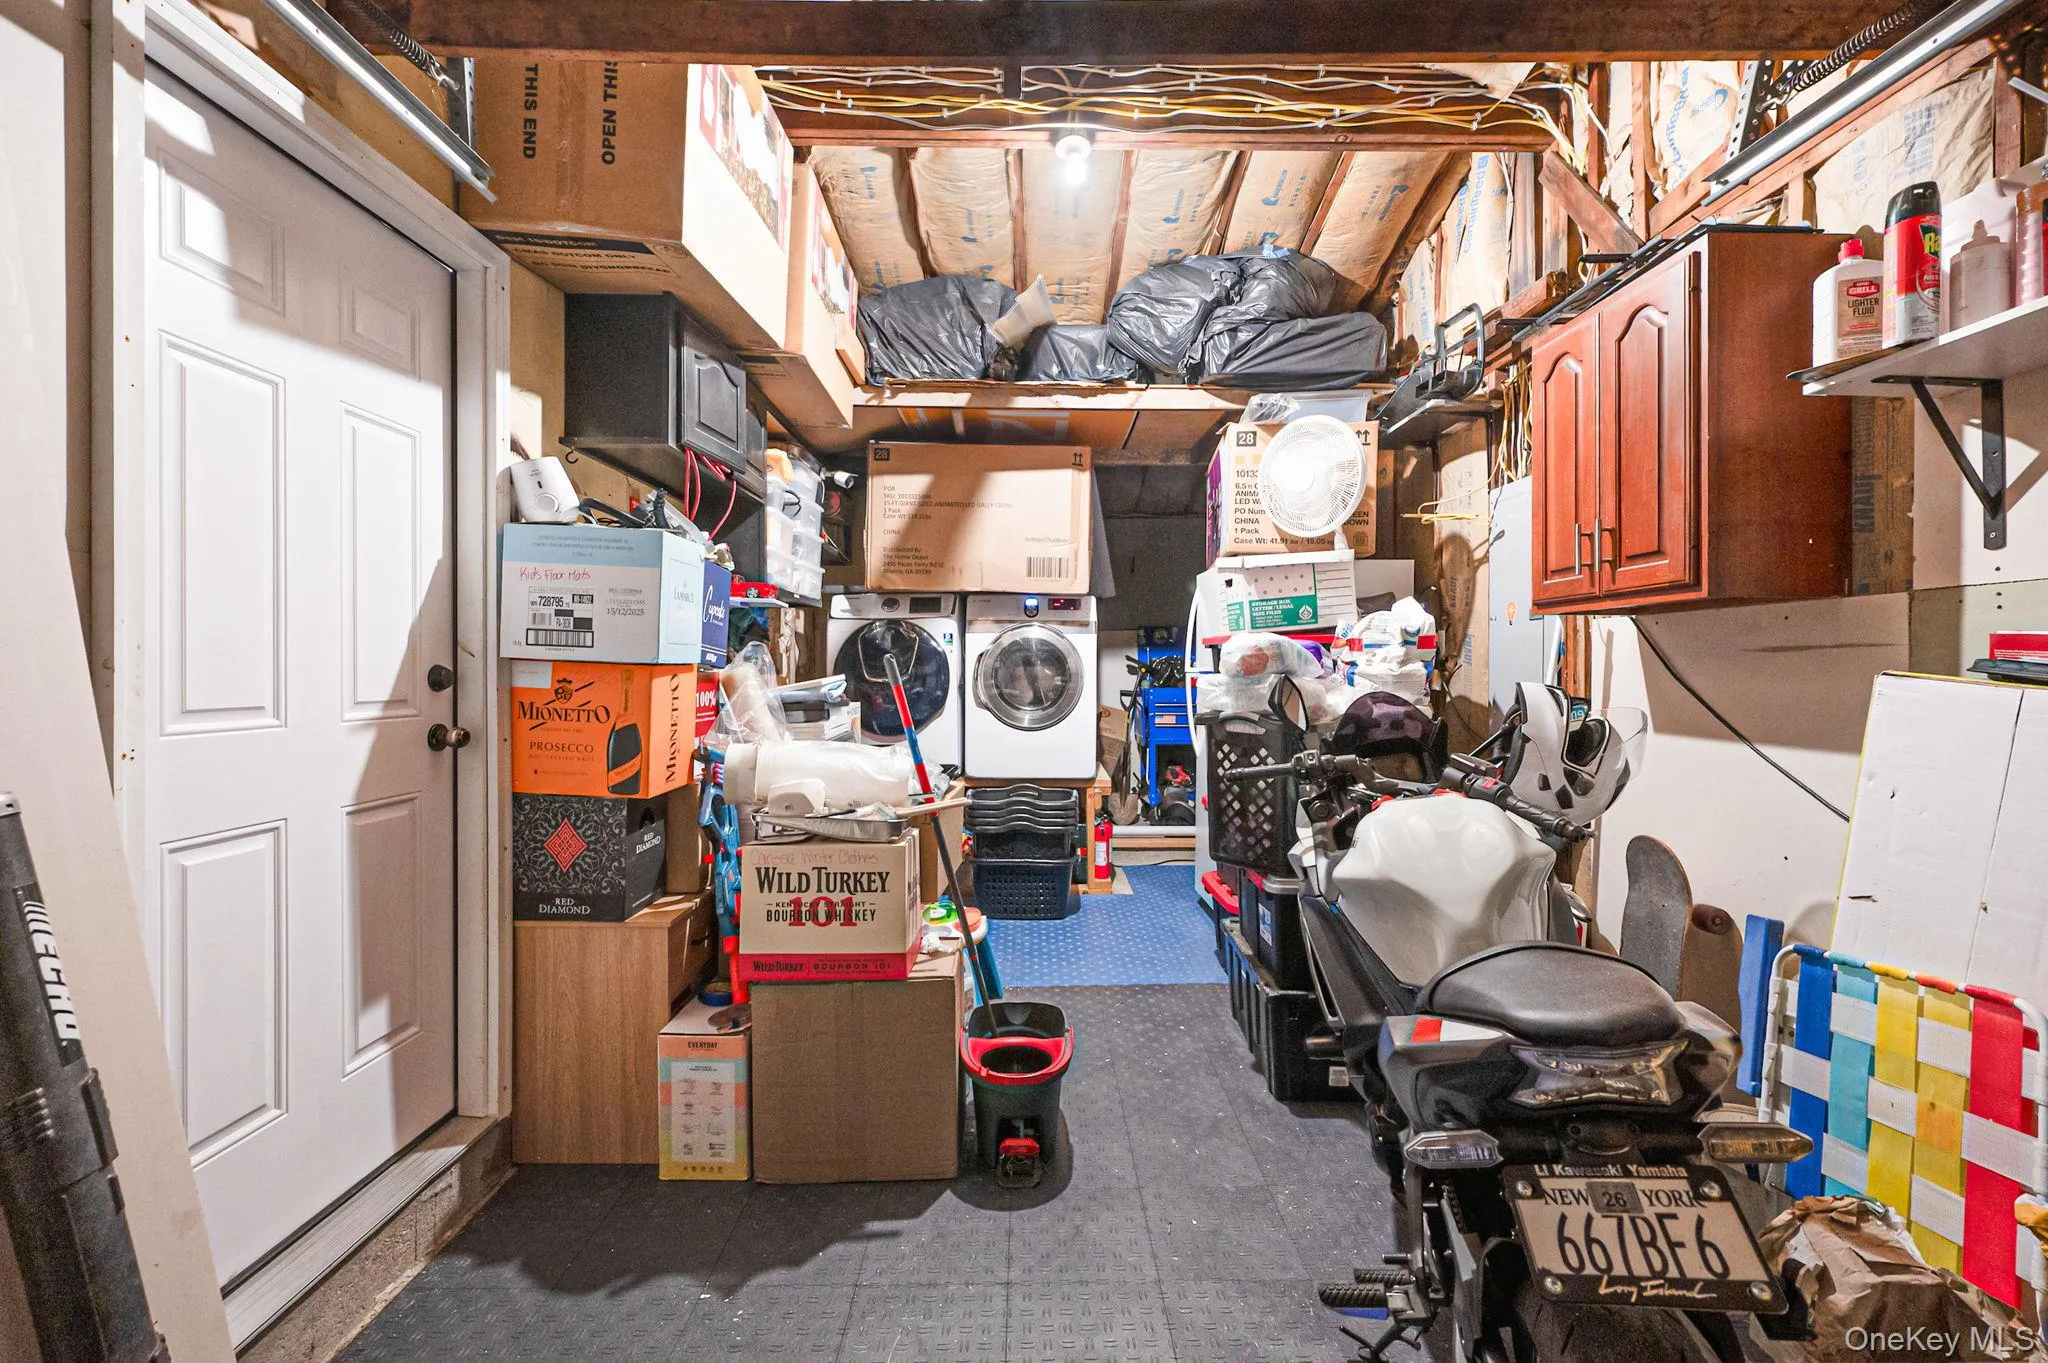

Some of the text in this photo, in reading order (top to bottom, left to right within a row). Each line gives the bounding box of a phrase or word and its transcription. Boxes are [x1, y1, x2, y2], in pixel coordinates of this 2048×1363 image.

[523, 63, 539, 159] THIS END
[601, 109, 617, 165] OPEN
[1848, 286, 1878, 295] GRILL
[1847, 298, 1879, 308] LIGHTER
[1853, 307, 1875, 316] FLUID
[1239, 433, 1254, 444] 28
[875, 449, 888, 459] 28
[1854, 474, 1881, 533] KNAUF
[519, 567, 541, 580] Kids
[544, 568, 565, 581] Floor
[538, 595, 564, 608] 728795
[696, 690, 716, 707] 100%
[517, 700, 611, 724] MIONETTO
[665, 673, 680, 784] MIONETTO
[529, 741, 594, 754] PROSECCO
[636, 836, 661, 854] DIAMOND
[801, 851, 834, 865] Winter
[755, 866, 891, 896] WILD TURKEY
[539, 905, 591, 915] DIAMOND
[766, 909, 876, 922] BOURBON WHISKEY
[788, 896, 857, 927] 101
[813, 962, 868, 970] BOURBON
[688, 1041, 717, 1049] EVERYDAY
[1554, 1164, 1623, 1177] Kawasaki
[1626, 1164, 1687, 1177] Yamaha
[1544, 1188, 1591, 1206] NEW
[1602, 1191, 1627, 1208] 26
[1600, 1274, 1717, 1303] Long Island
